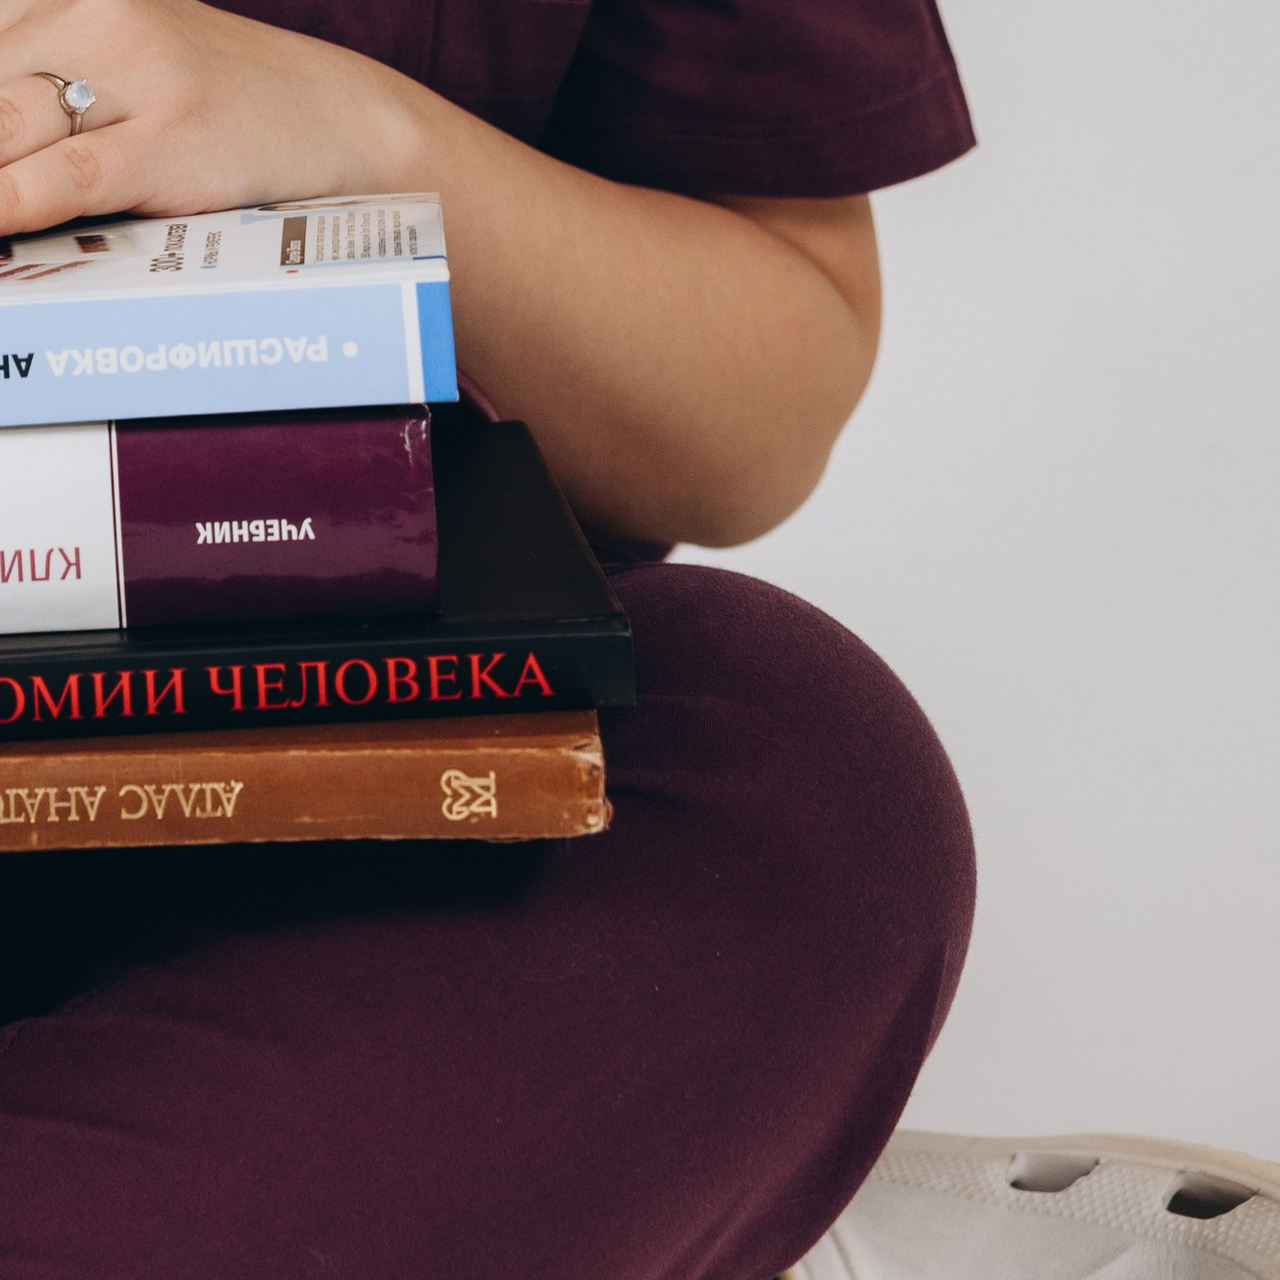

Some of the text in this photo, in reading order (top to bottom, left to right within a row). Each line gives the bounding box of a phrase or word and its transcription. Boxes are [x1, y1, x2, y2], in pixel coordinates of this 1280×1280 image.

[46, 336, 327, 376] РАСШИФРОВКА
[196, 518, 315, 544] УЧЕБНИК
[208, 653, 552, 709] ЧЕЛОВЕКА
[120, 781, 243, 819] АТЛАС
